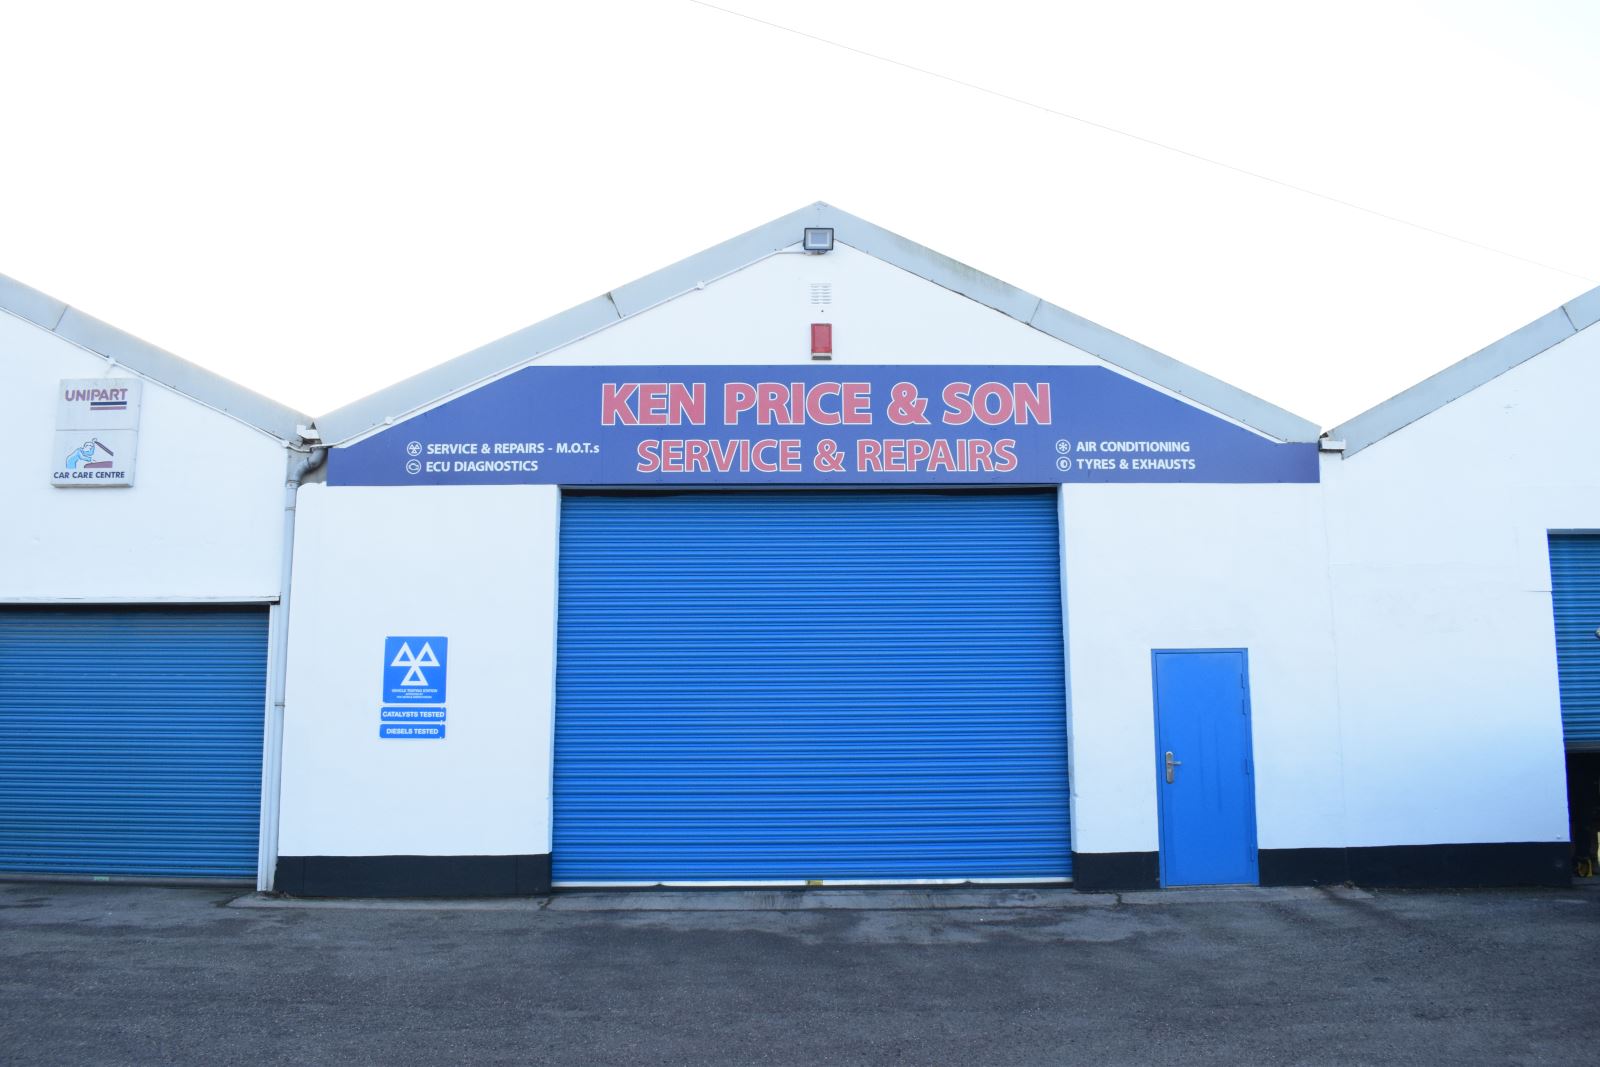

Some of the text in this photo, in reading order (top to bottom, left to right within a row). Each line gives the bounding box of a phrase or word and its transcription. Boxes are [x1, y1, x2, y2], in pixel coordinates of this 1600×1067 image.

[65, 388, 128, 401] UNIPART
[601, 382, 1051, 425] KEN PRICE & SON
[427, 443, 478, 455] SERVICE
[481, 443, 491, 454] &
[494, 443, 545, 454] REPAIRS
[556, 442, 600, 454] M.O.T.s
[1076, 441, 1190, 453] AIR CONDITIONING
[636, 439, 1018, 473] SERVICE & REPAIRS
[426, 460, 538, 473] ECU DIAGNOSTICS
[1076, 458, 1196, 470] TYRES & EXHAUSTS
[72, 471, 93, 479] CARE
[95, 471, 126, 479] CENTRE
